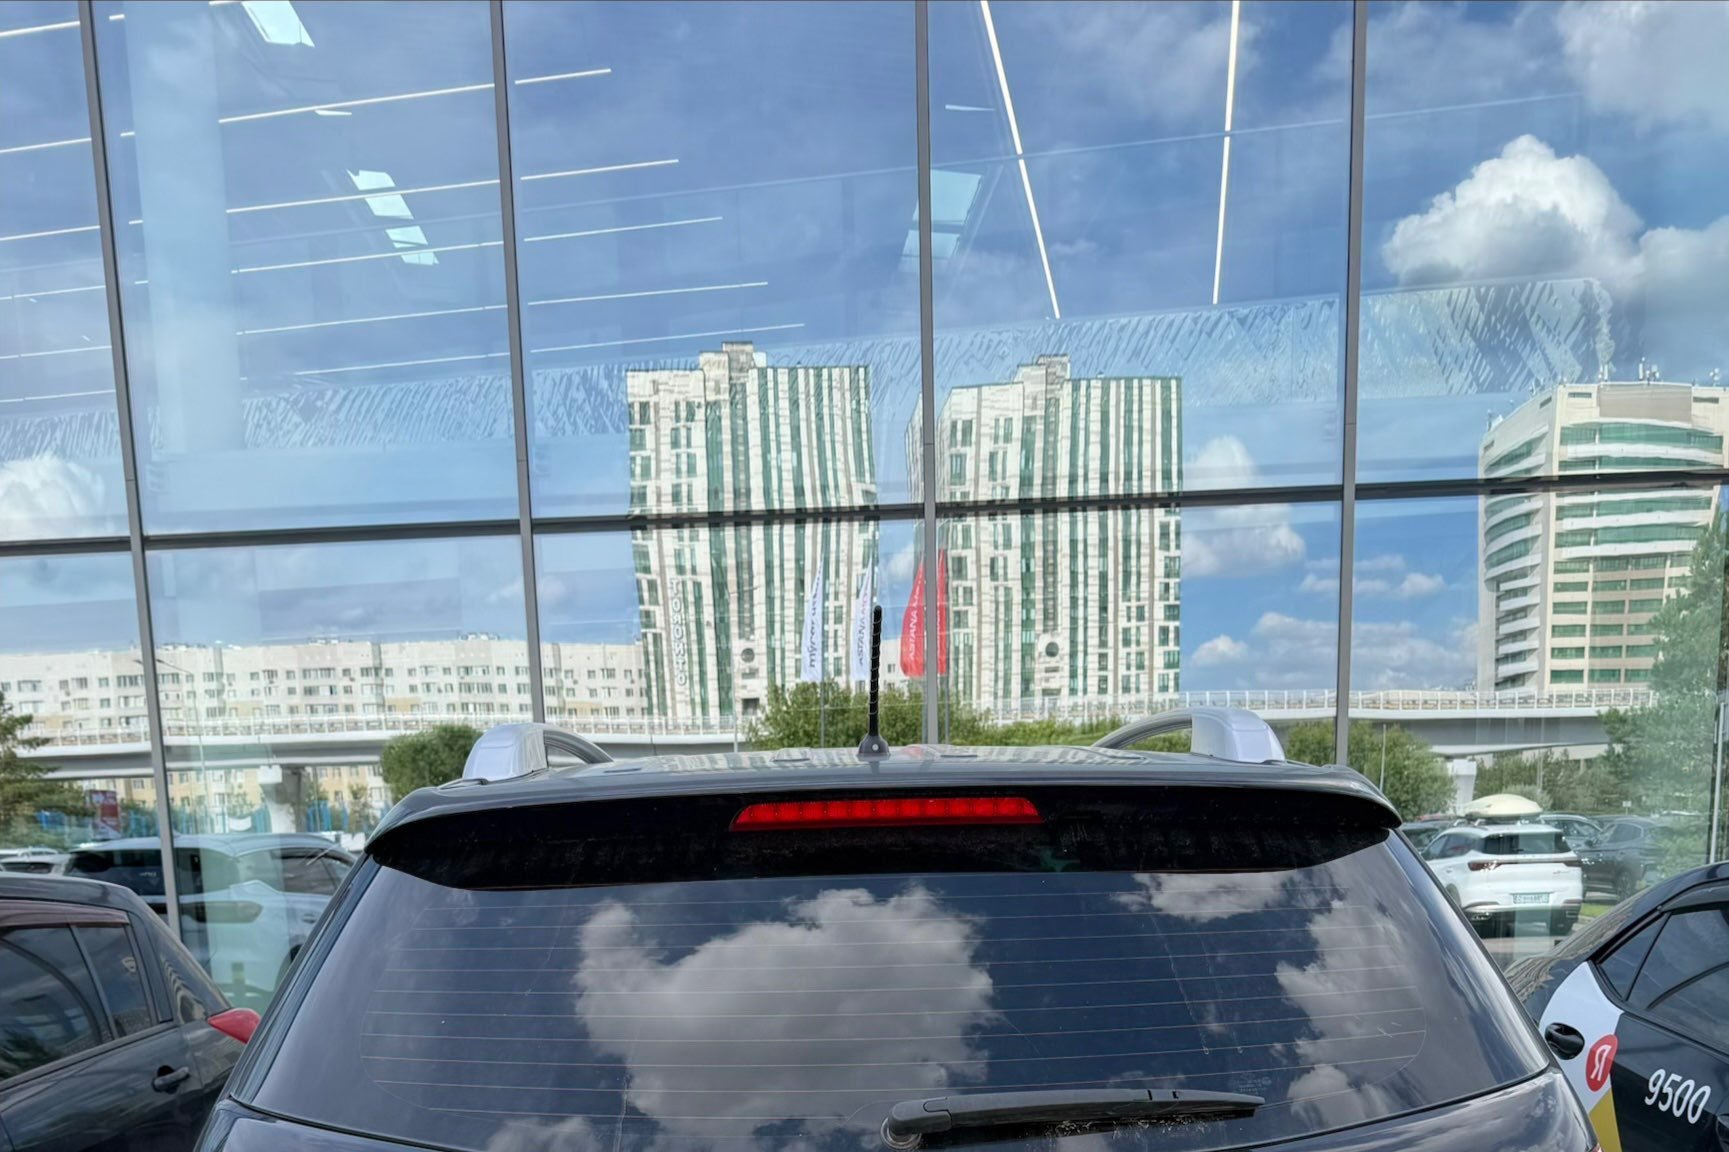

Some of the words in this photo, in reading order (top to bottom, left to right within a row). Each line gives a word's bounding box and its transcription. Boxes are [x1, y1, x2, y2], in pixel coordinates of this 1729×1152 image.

[908, 611, 919, 661] ASTANA
[1590, 1043, 1609, 1082] Я
[1644, 1068, 1711, 1125] 9500
